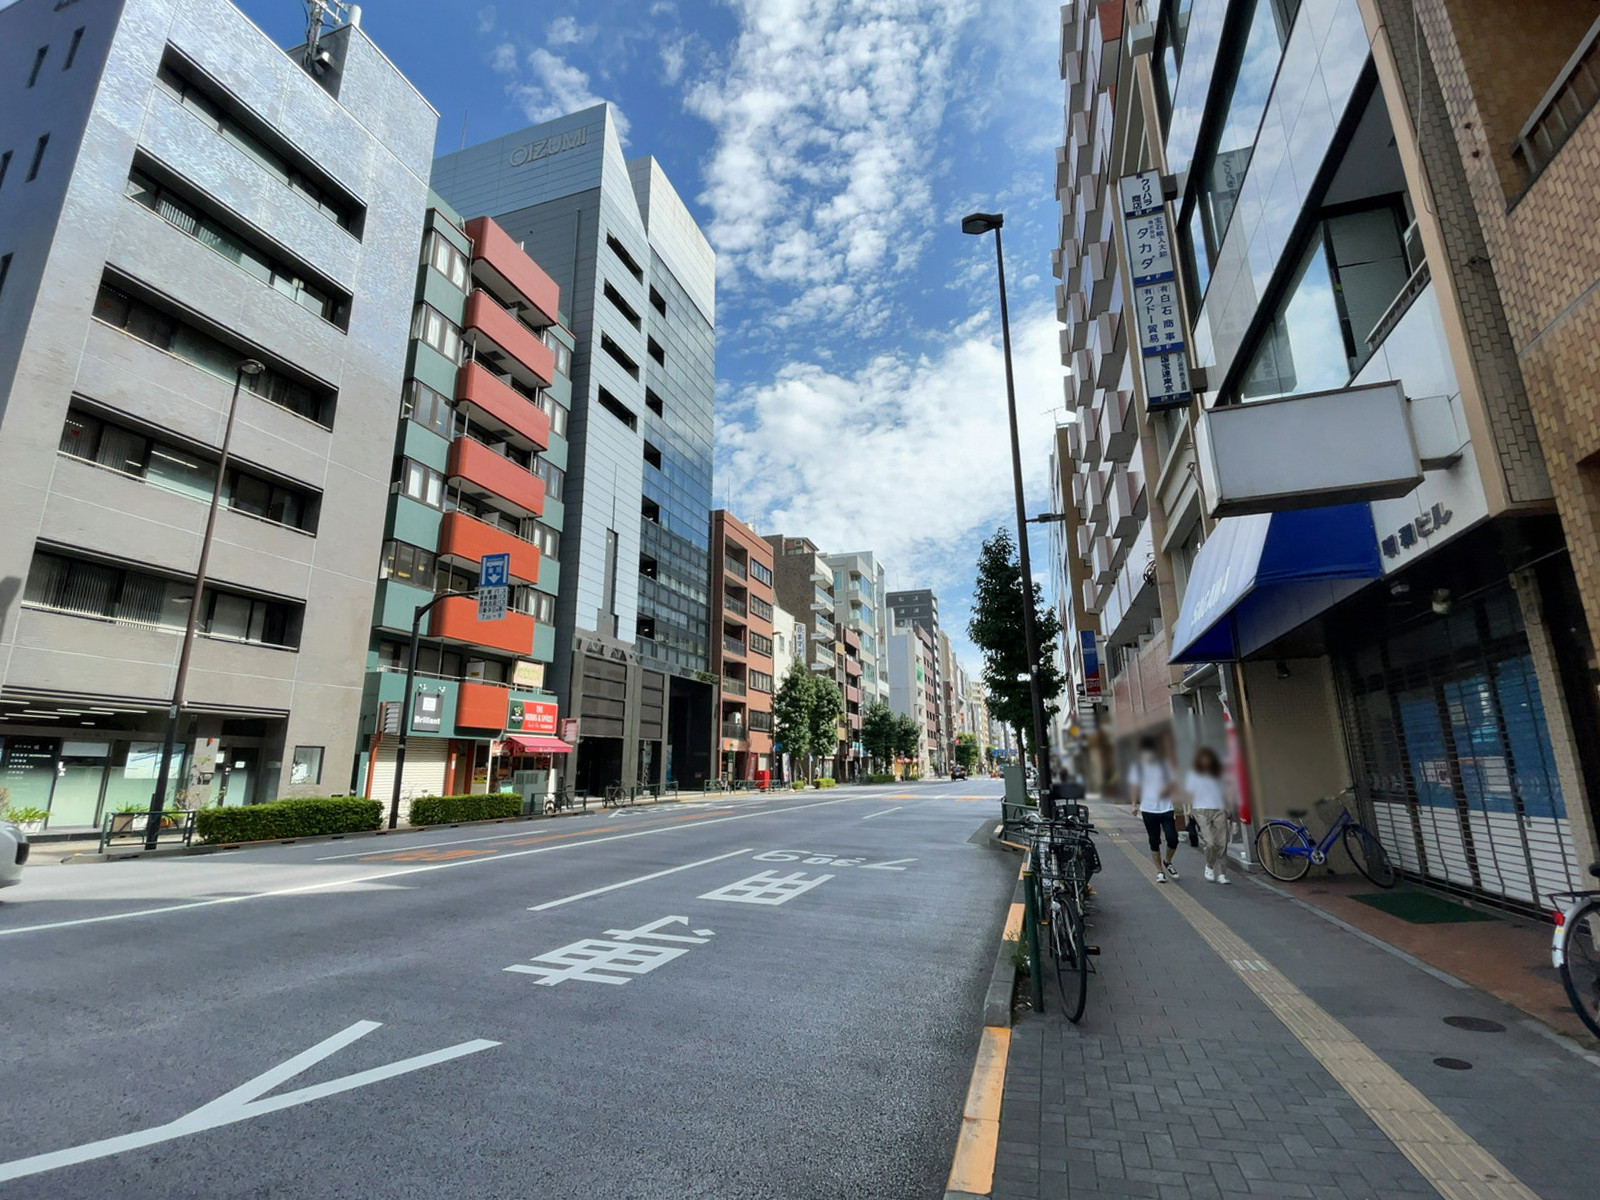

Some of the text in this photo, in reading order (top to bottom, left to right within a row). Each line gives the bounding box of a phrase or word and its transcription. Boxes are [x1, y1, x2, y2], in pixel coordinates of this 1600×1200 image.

[509, 127, 588, 168] OIZUMI
[1141, 178, 1153, 206] クリハラ
[1137, 228, 1156, 270] タカダ
[414, 715, 441, 725] Brilliant
